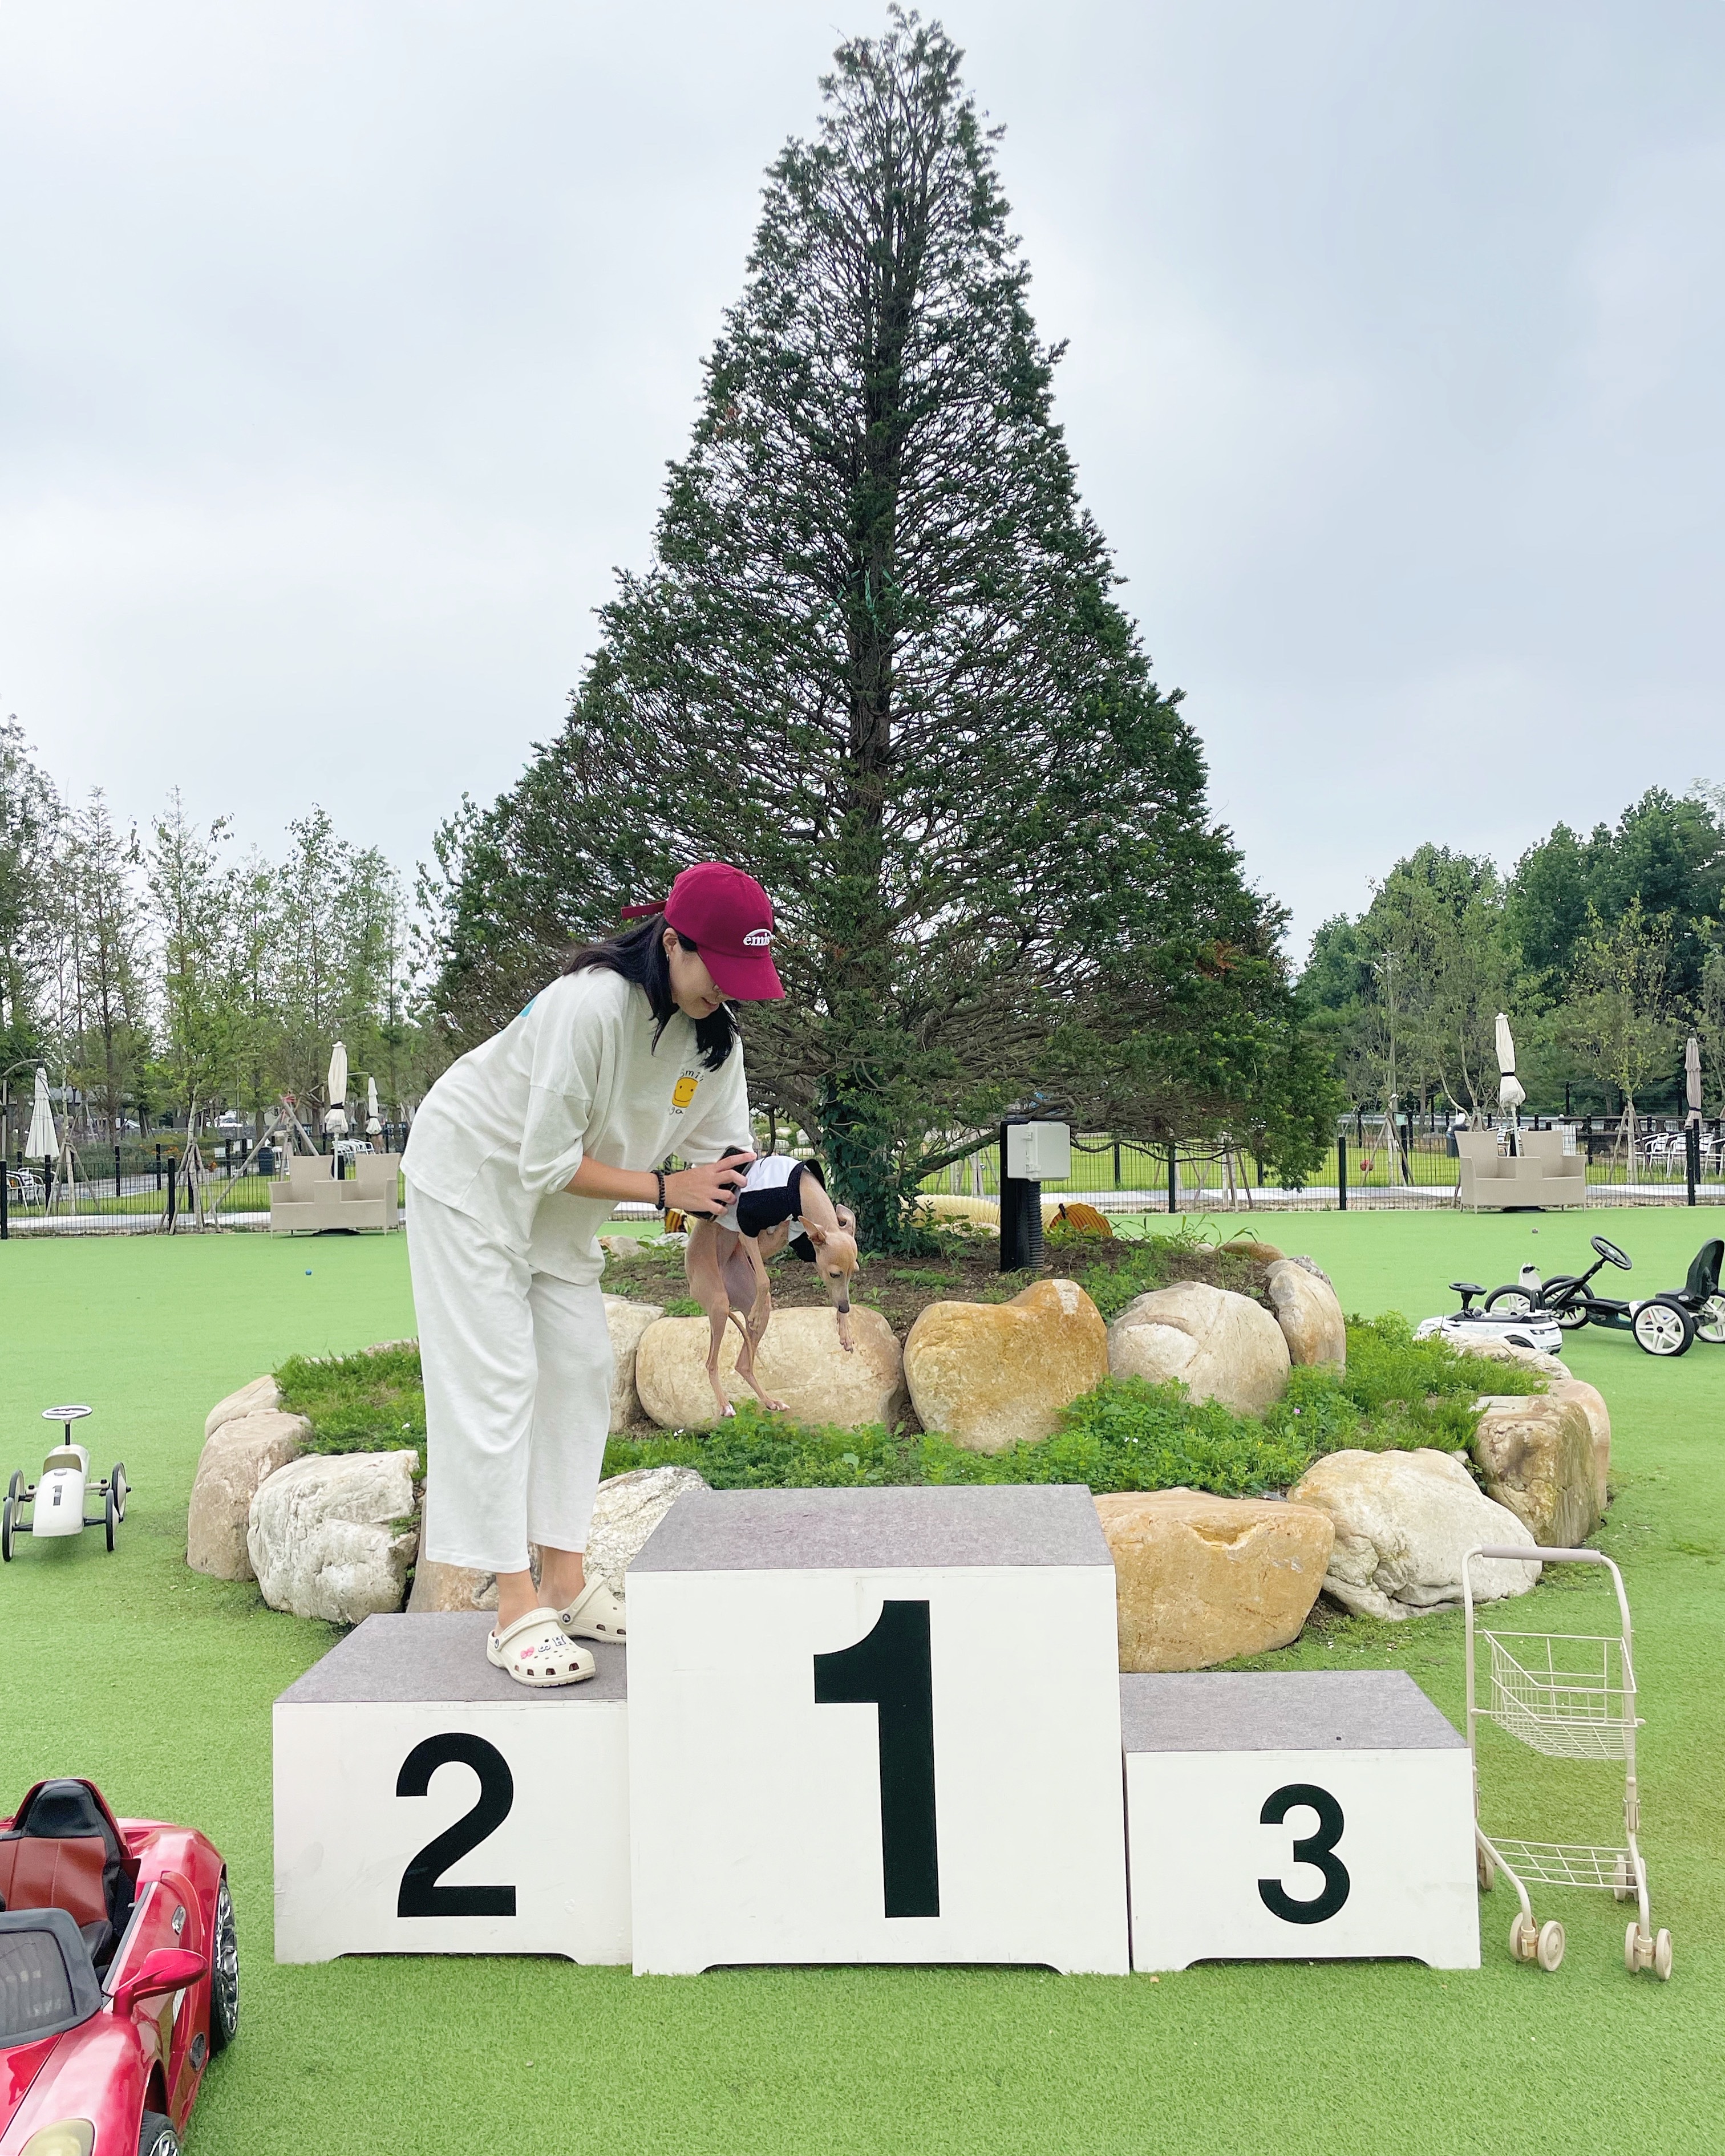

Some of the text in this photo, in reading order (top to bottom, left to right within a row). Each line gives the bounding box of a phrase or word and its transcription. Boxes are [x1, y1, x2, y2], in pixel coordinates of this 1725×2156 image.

[52, 1485, 63, 1506] 1
[396, 1733, 516, 1918] 2
[813, 1600, 940, 1919] 1
[1258, 1784, 1350, 1924] 3
